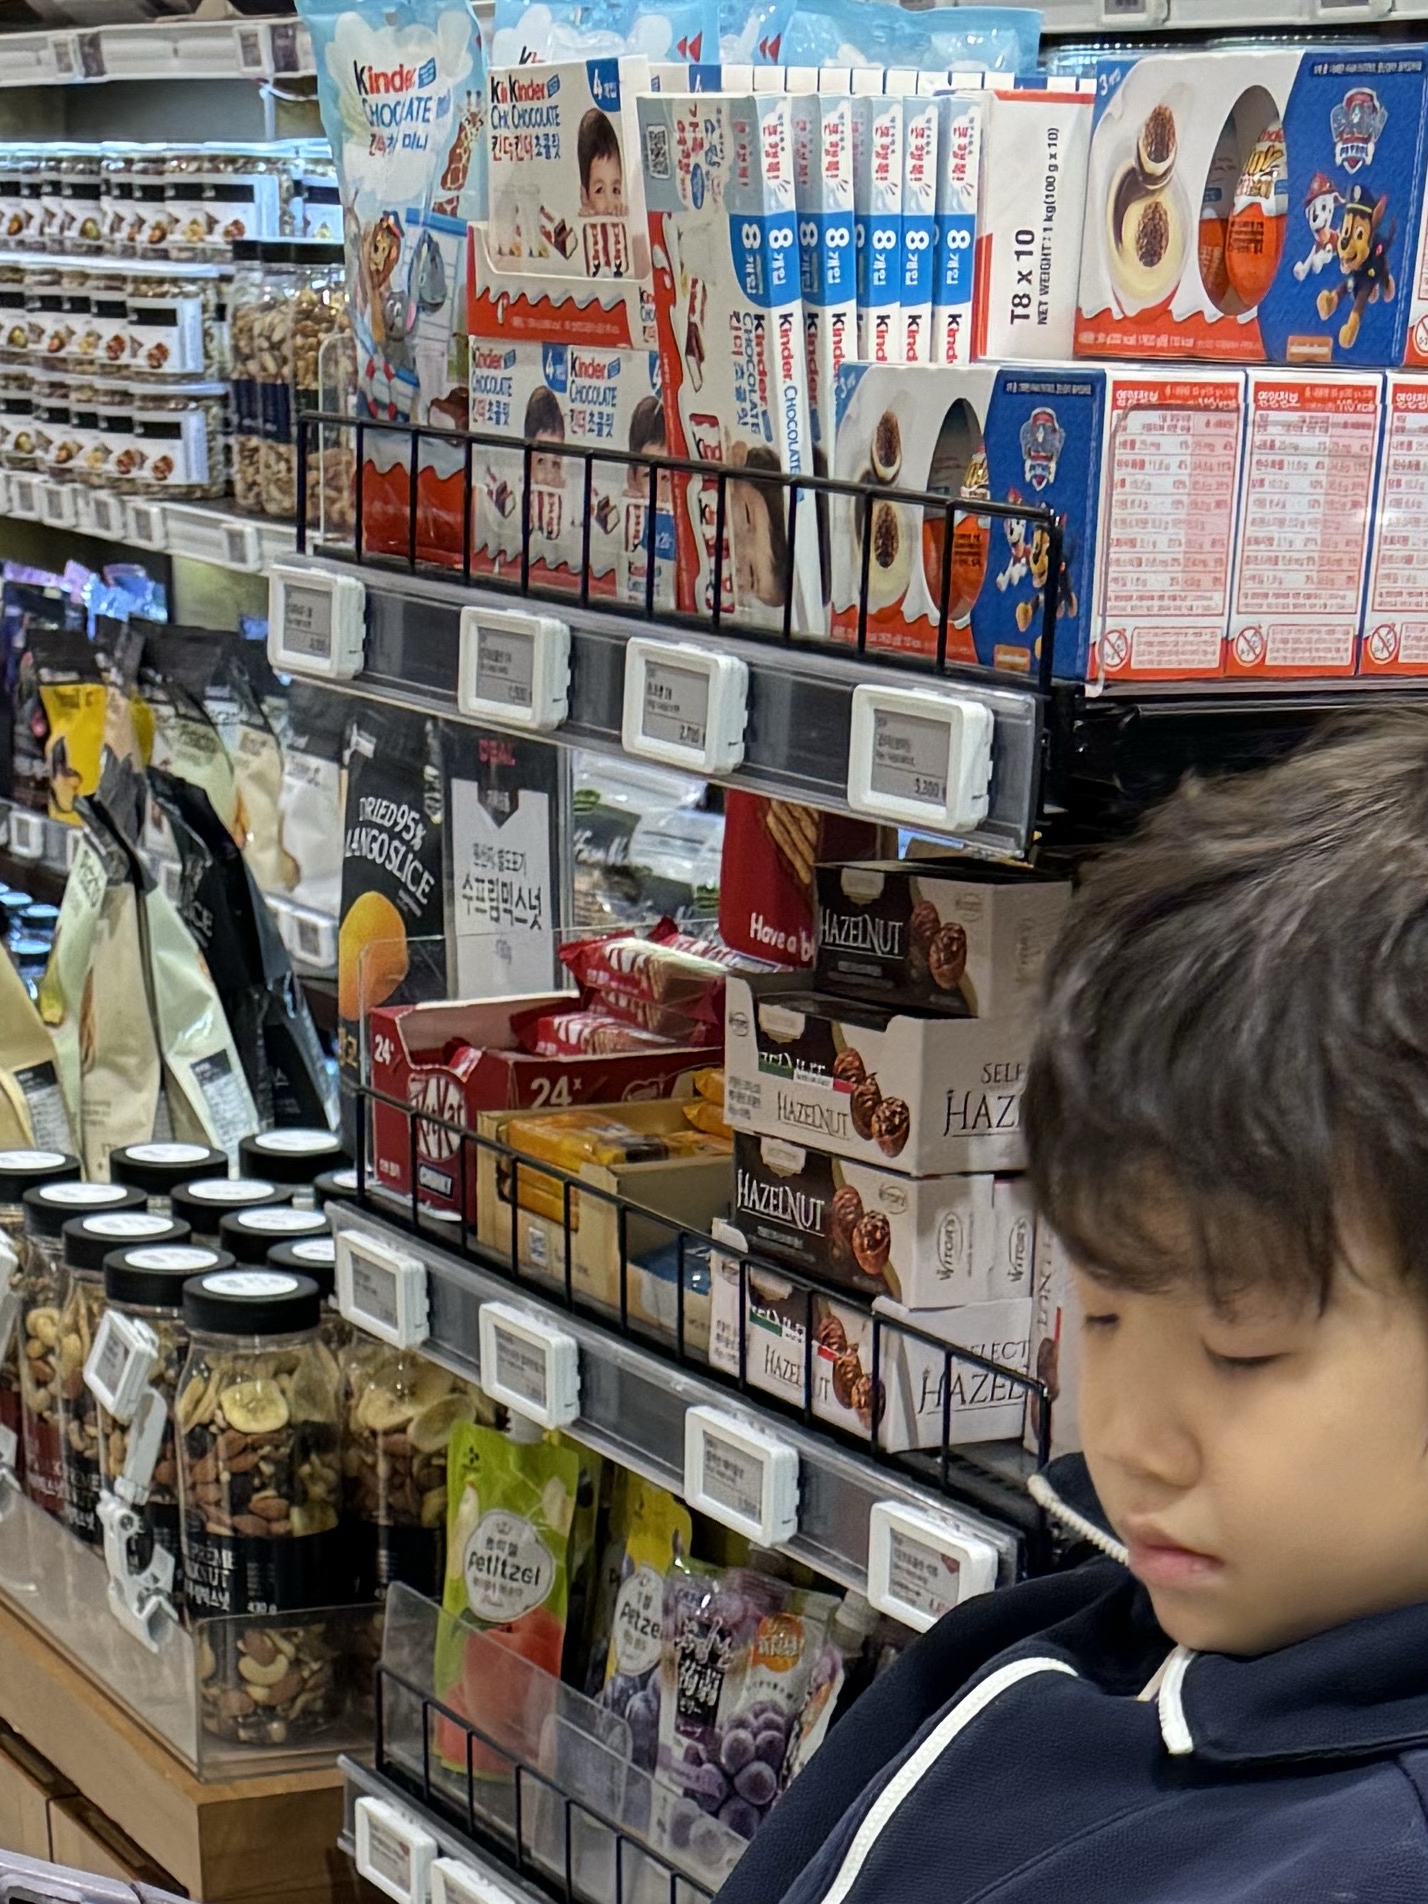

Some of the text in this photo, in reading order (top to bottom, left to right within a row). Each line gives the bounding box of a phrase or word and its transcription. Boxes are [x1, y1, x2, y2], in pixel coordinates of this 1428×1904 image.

[741, 223, 761, 249] 8
[769, 227, 794, 249] 8
[825, 227, 850, 249] 8
[873, 229, 897, 250] 8
[905, 230, 930, 250] 8
[946, 229, 971, 250] 8
[1014, 229, 1035, 262] 10
[1010, 293, 1032, 325] T8
[779, 312, 795, 385] Kinder
[750, 911, 784, 947] Have
[944, 1088, 1021, 1137] HAZ
[737, 1169, 826, 1231] HAZELNUT
